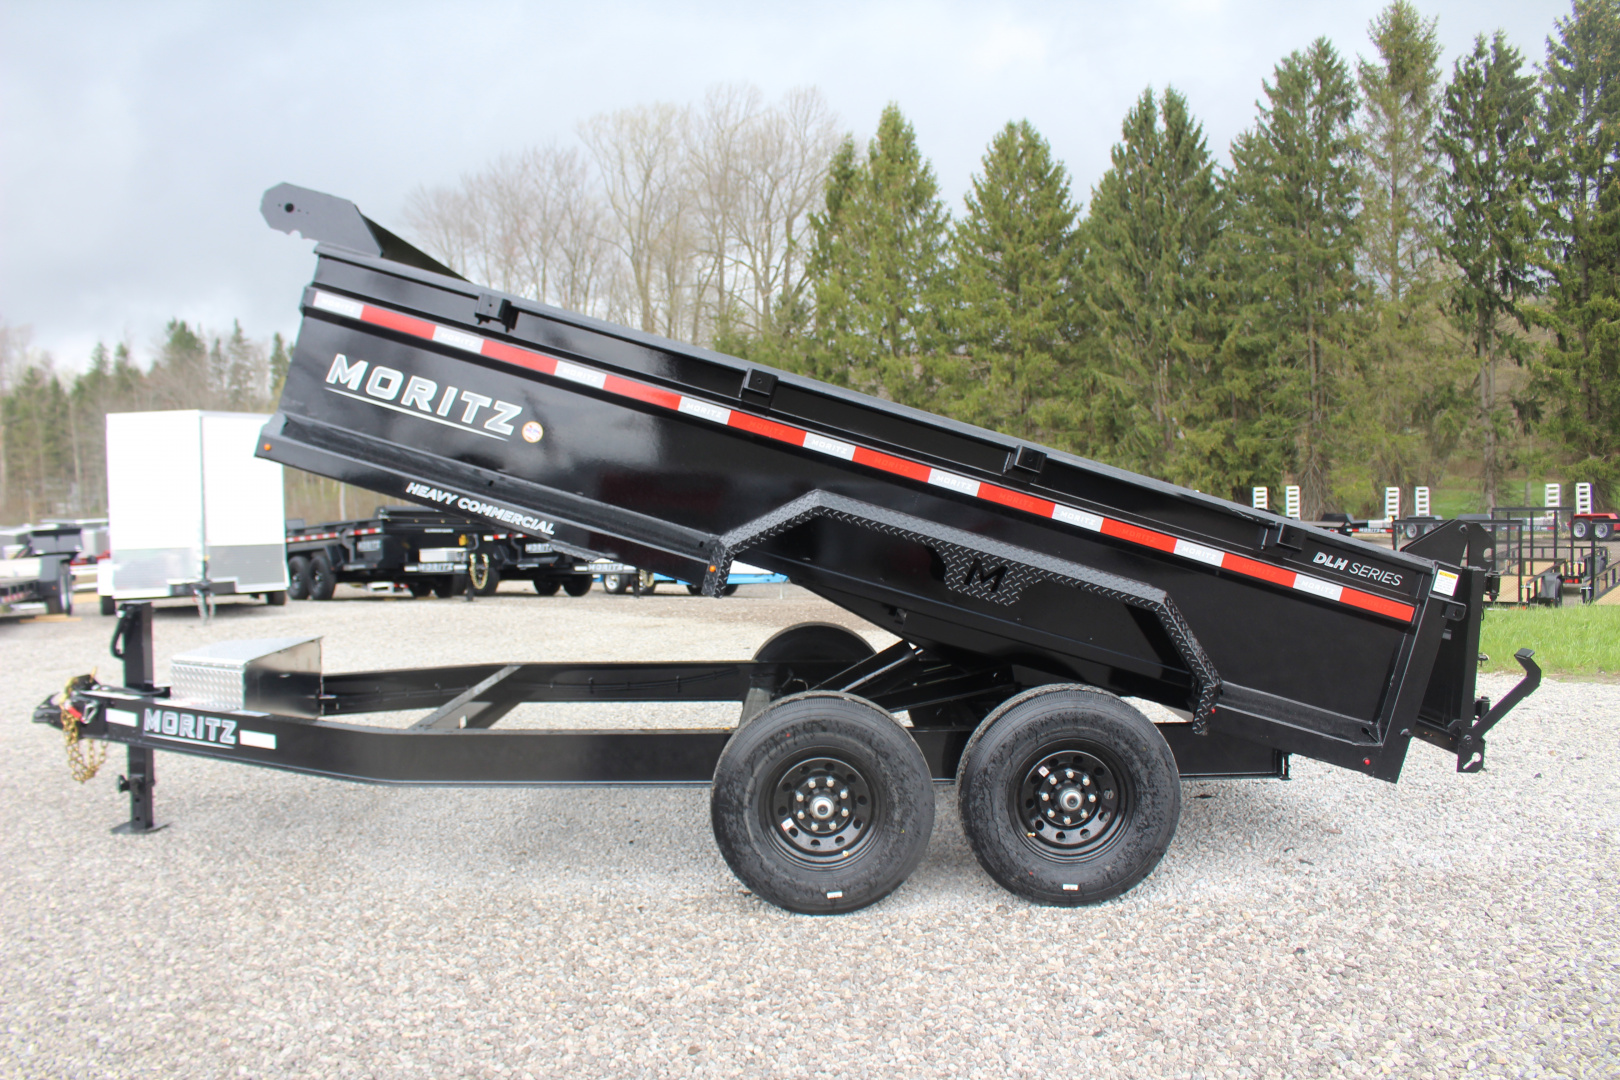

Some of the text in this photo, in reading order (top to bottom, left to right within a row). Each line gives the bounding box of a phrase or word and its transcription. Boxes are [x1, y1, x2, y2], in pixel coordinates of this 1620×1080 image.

[440, 332, 477, 347] MORITZ
[562, 367, 599, 382] MORITZ
[325, 353, 523, 436] MORITZ
[686, 402, 722, 418] MORITZ
[749, 422, 785, 437] MORITZ
[811, 438, 848, 454] MORITZ
[873, 457, 910, 472] MORITZ
[935, 475, 973, 491] MORITZ
[405, 482, 555, 535] HEAVY COMMERCIAL
[1060, 510, 1096, 526] MORITZ
[1182, 545, 1217, 560] MORITZ
[418, 563, 454, 572] MORITZ
[588, 563, 624, 571] MORITZ
[964, 558, 1008, 592] M
[1313, 552, 1403, 586] DLH SERIES
[1301, 580, 1336, 595] MORITZ
[144, 708, 237, 745] MORITZ
